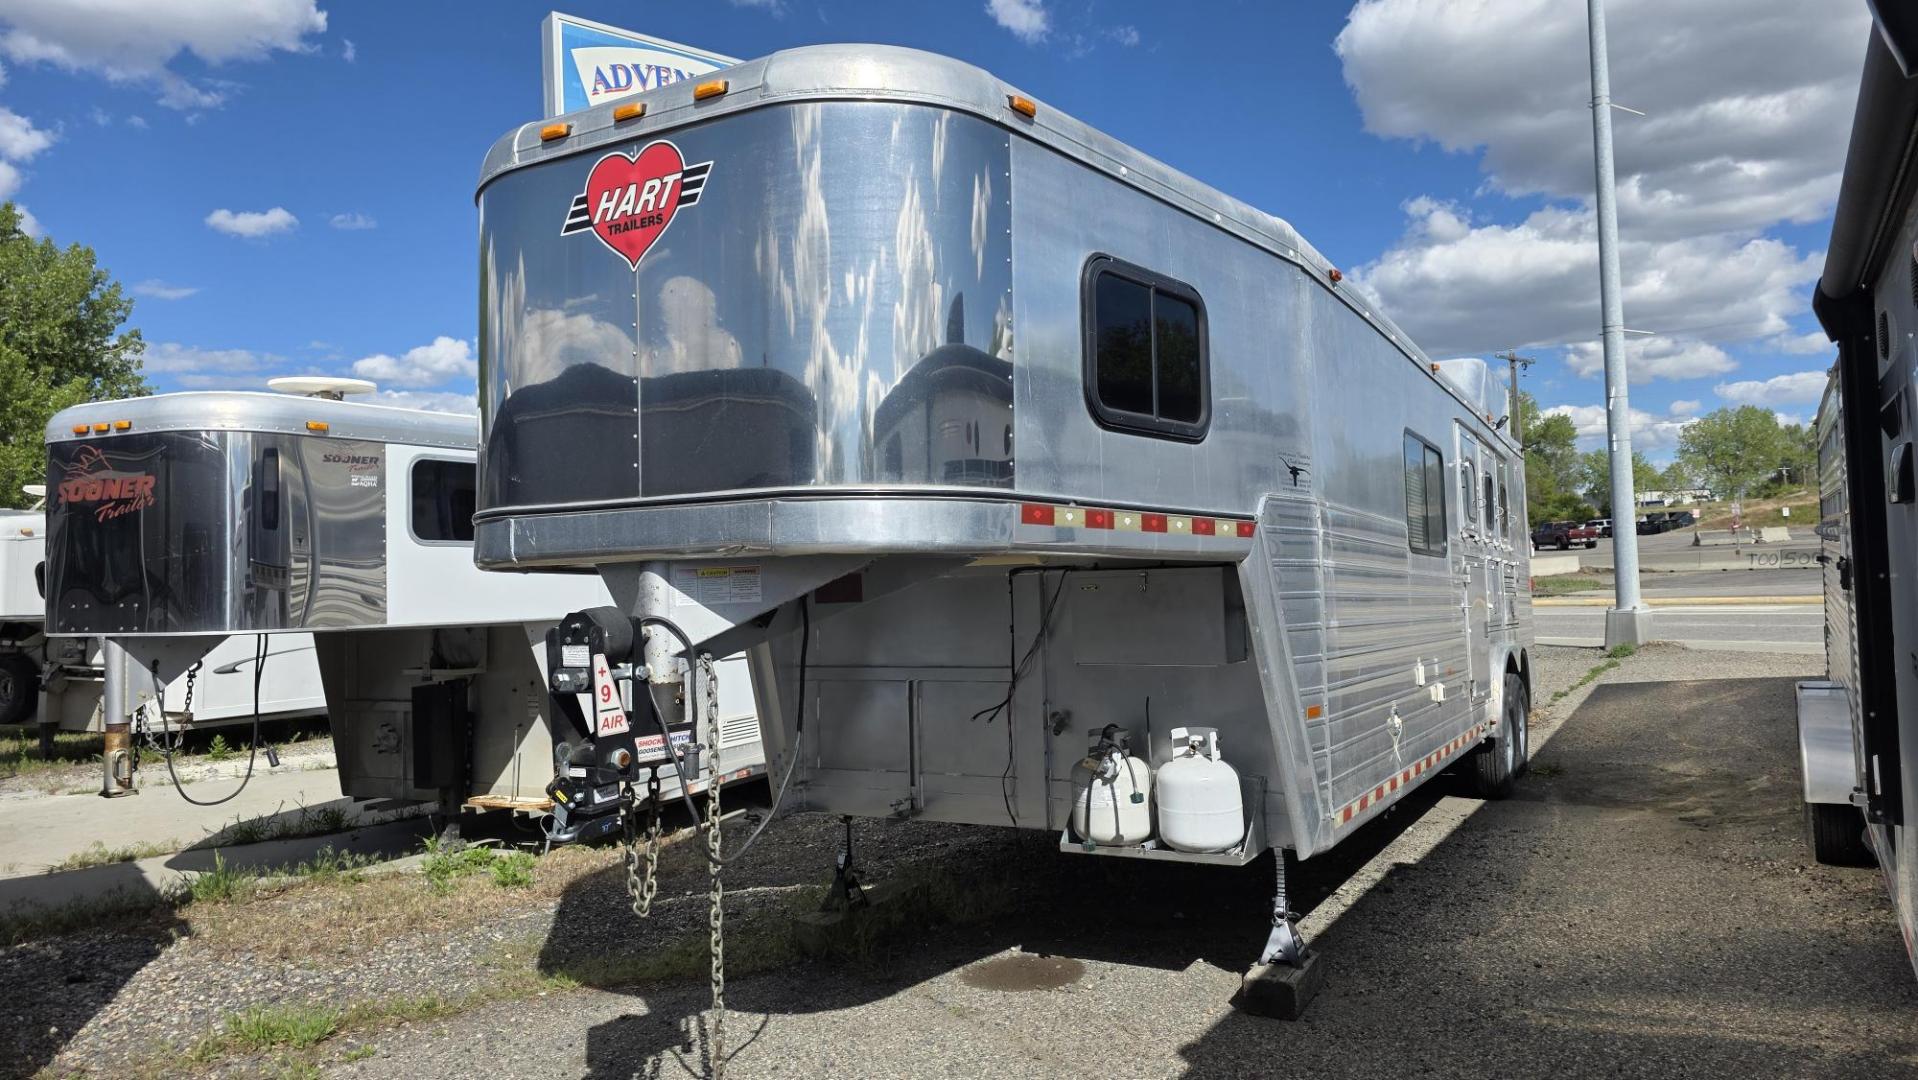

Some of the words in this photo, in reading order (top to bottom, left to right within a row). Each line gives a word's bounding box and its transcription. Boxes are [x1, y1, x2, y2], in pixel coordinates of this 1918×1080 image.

[592, 172, 684, 226] HART
[608, 213, 664, 237] TRAILERS
[322, 454, 379, 465] SOONER
[58, 474, 156, 504] SOONER
[1746, 552, 1779, 566] TOO
[601, 684, 612, 704] 9
[601, 714, 624, 731] AIR
